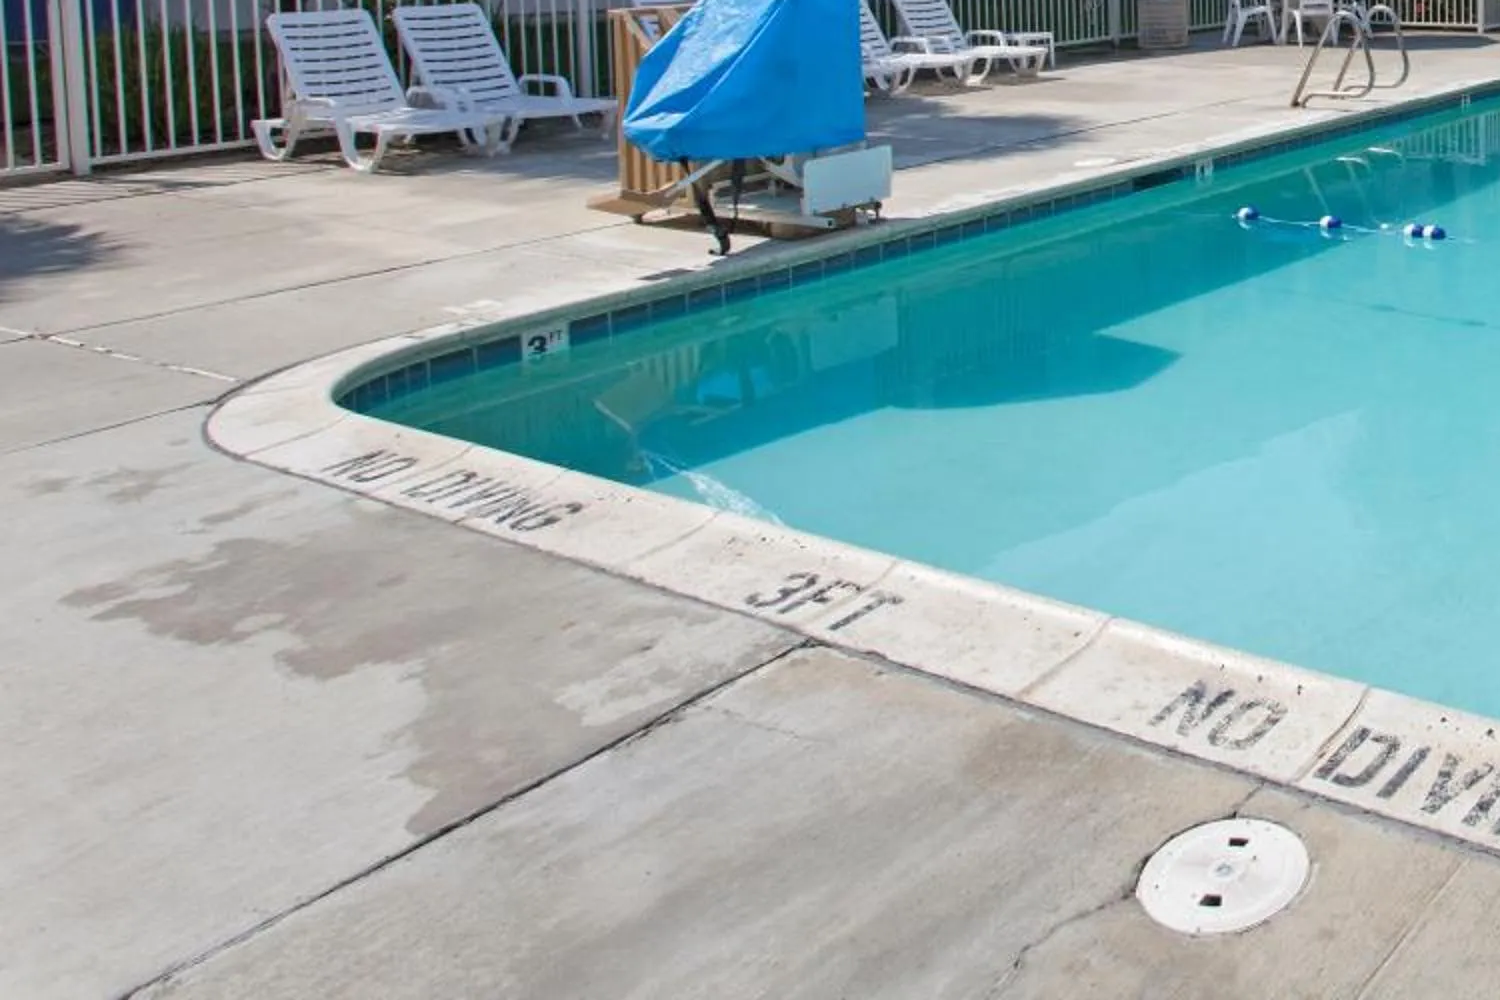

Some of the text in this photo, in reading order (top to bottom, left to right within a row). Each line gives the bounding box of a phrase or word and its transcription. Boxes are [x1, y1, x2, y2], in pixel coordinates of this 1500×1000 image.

[322, 448, 583, 533] NO DIVING
[1148, 679, 1289, 751] NO
